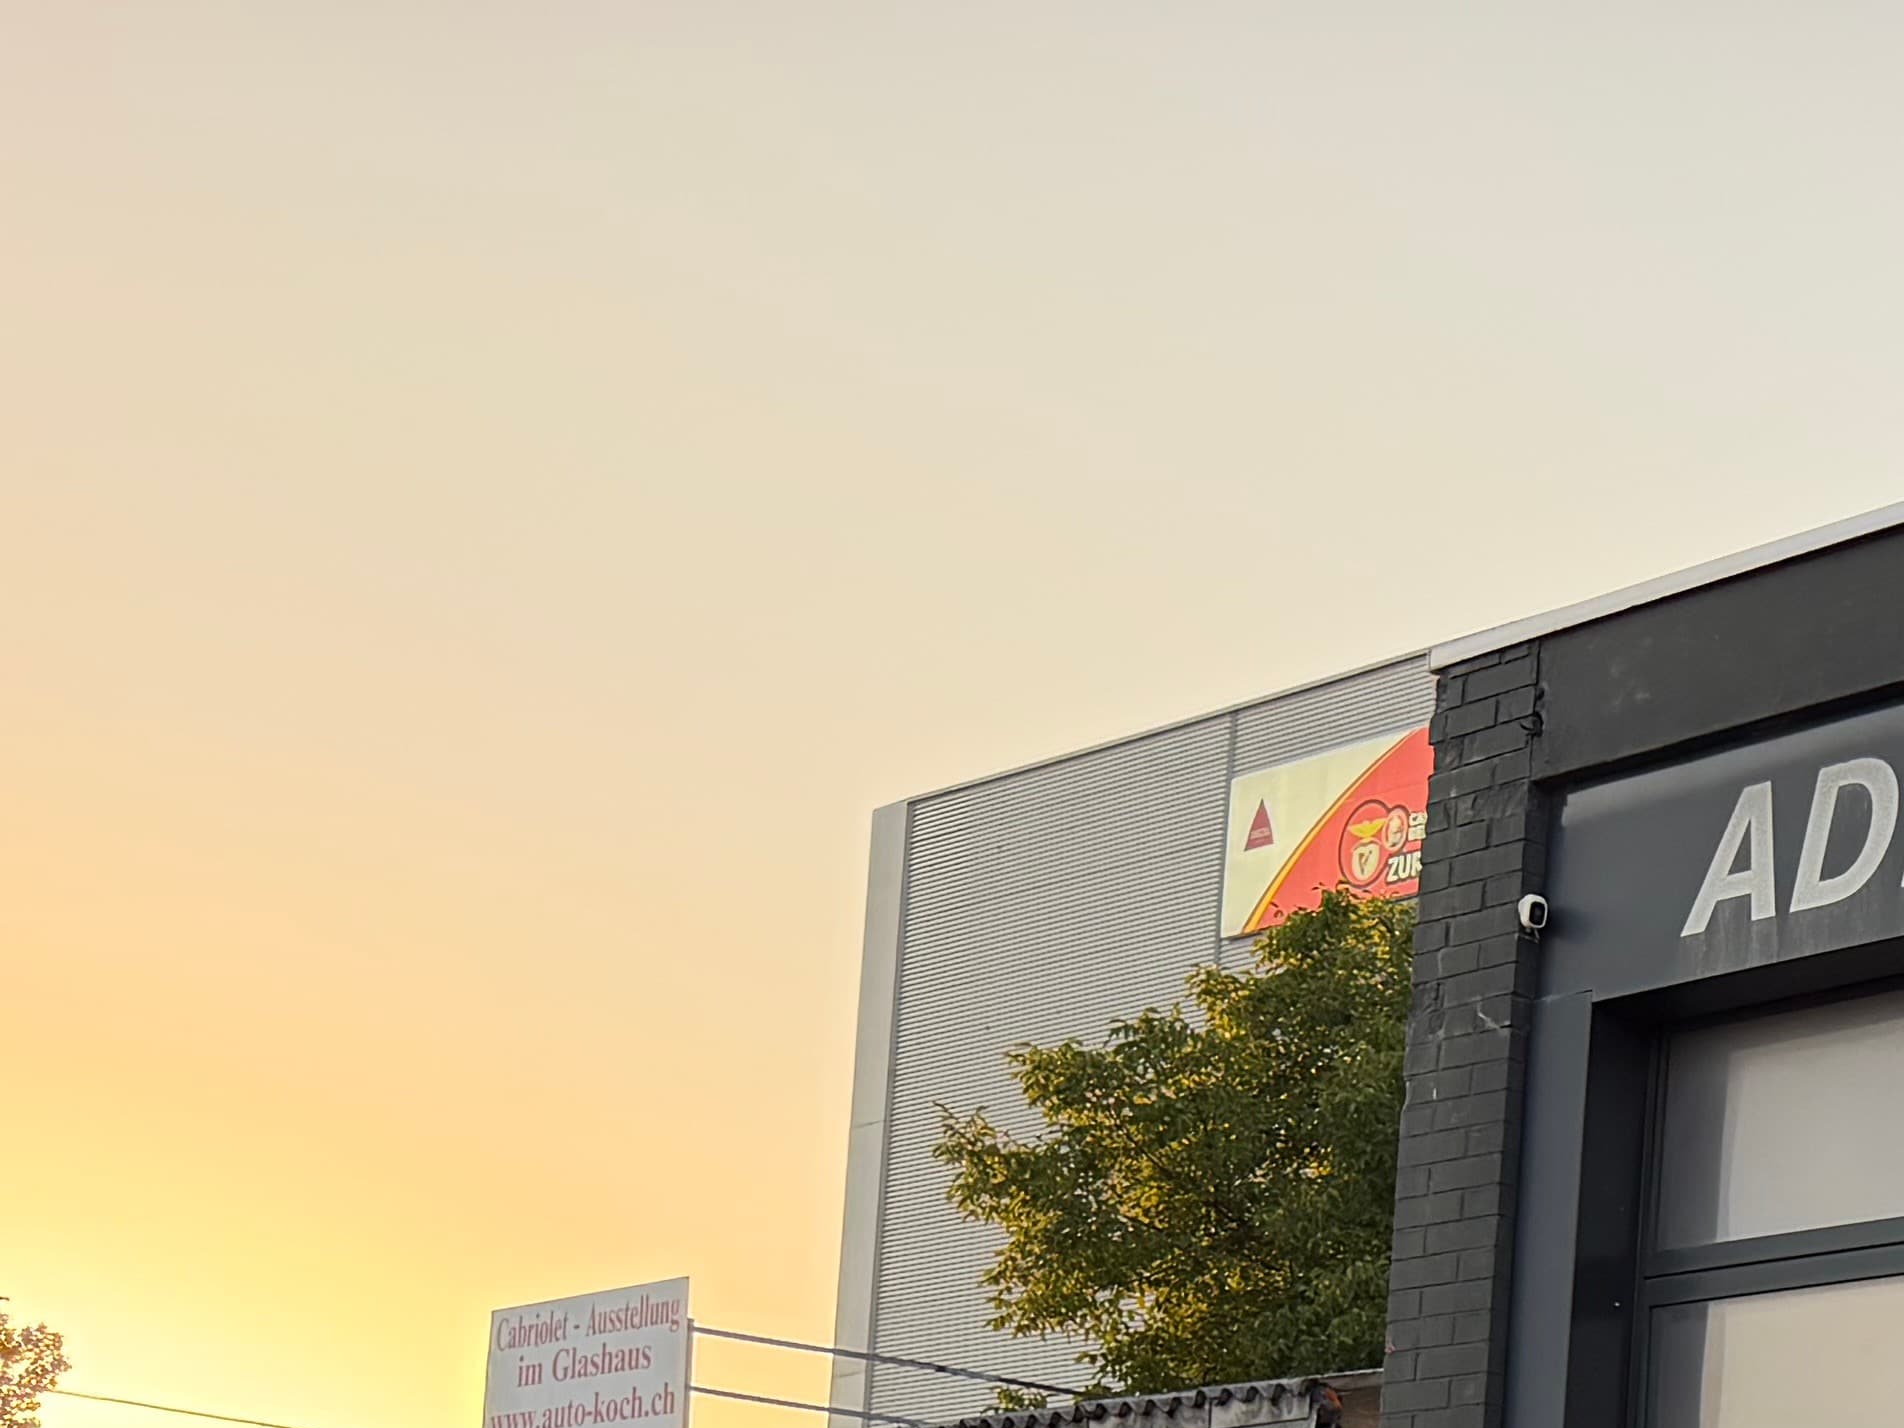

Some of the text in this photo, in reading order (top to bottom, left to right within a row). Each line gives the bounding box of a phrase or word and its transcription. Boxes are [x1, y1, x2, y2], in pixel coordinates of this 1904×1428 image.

[497, 1310, 567, 1351] Cabriolet
[586, 1293, 681, 1336] Ausstellung
[517, 1342, 652, 1387] im Glashaus
